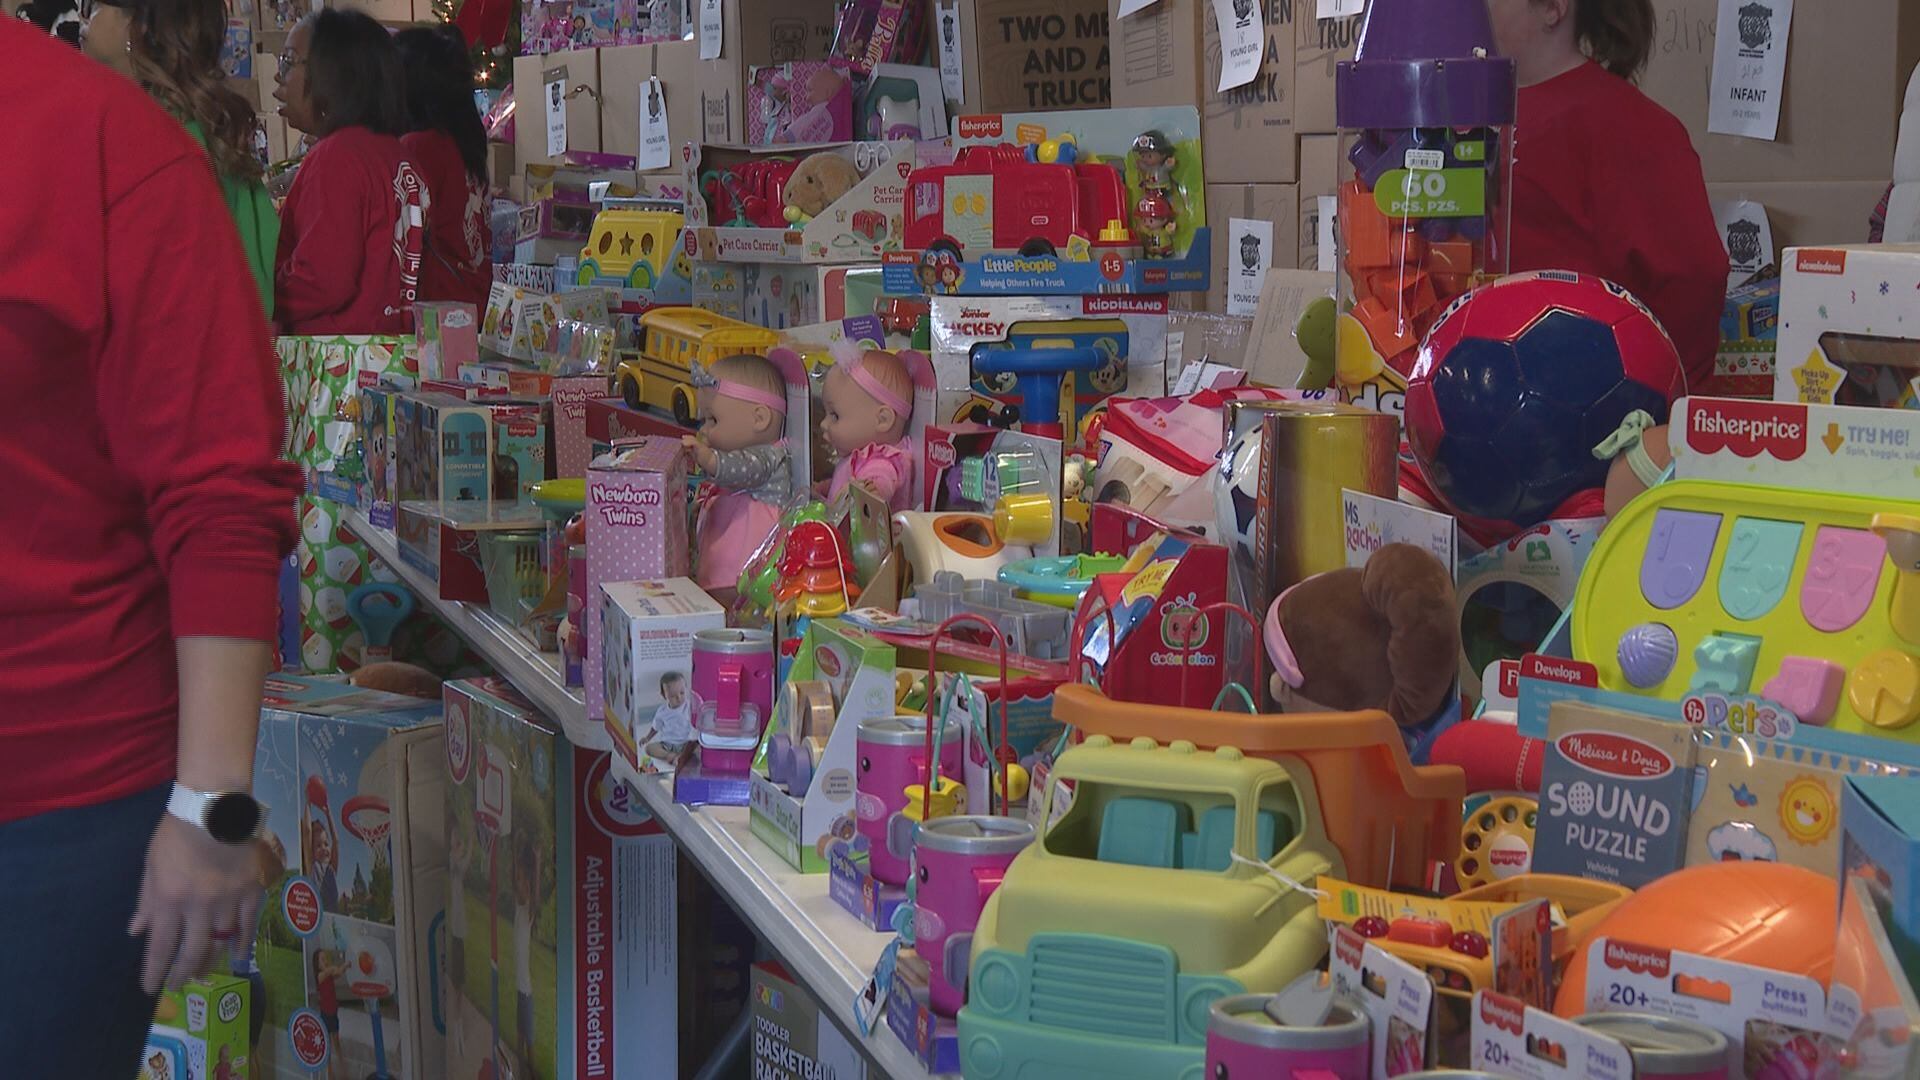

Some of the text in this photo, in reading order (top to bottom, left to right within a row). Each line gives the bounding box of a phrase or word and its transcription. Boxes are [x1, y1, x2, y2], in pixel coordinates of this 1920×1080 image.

[998, 15, 1066, 43] TWO
[1023, 47, 1087, 75] AND
[1230, 43, 1259, 58] YOUNG GIRL
[1267, 34, 1279, 64] A
[1730, 88, 1767, 103] INFANT
[1459, 144, 1474, 156] 1+
[1401, 172, 1447, 198] 60
[723, 239, 778, 251] Pet Care Carrier
[1103, 260, 1120, 272] 1-5
[980, 277, 1065, 289] Helping Others Fire Truck
[1233, 294, 1252, 304] YOUNG
[1693, 409, 1802, 442] fisher-price
[984, 455, 997, 481] 12
[590, 483, 660, 506] Newborn
[600, 506, 646, 527] Twins
[1150, 651, 1216, 666] CoCoelon
[1534, 661, 1581, 682] Develops
[1567, 737, 1618, 762] Melissa
[1631, 752, 1662, 774] Doug
[1548, 781, 1670, 836] SOUND
[1566, 822, 1648, 863] PUZZLE
[582, 855, 605, 965] Adjustable
[1606, 944, 1668, 968] fisher-price
[1609, 983, 1650, 1008] 20+
[1763, 981, 1808, 1004] Press
[1762, 998, 1808, 1018] buttons!
[586, 969, 605, 1077] Basketball
[755, 1015, 790, 1043] TODDLER
[1484, 1039, 1511, 1065] 20+
[1586, 1044, 1619, 1071] Press
